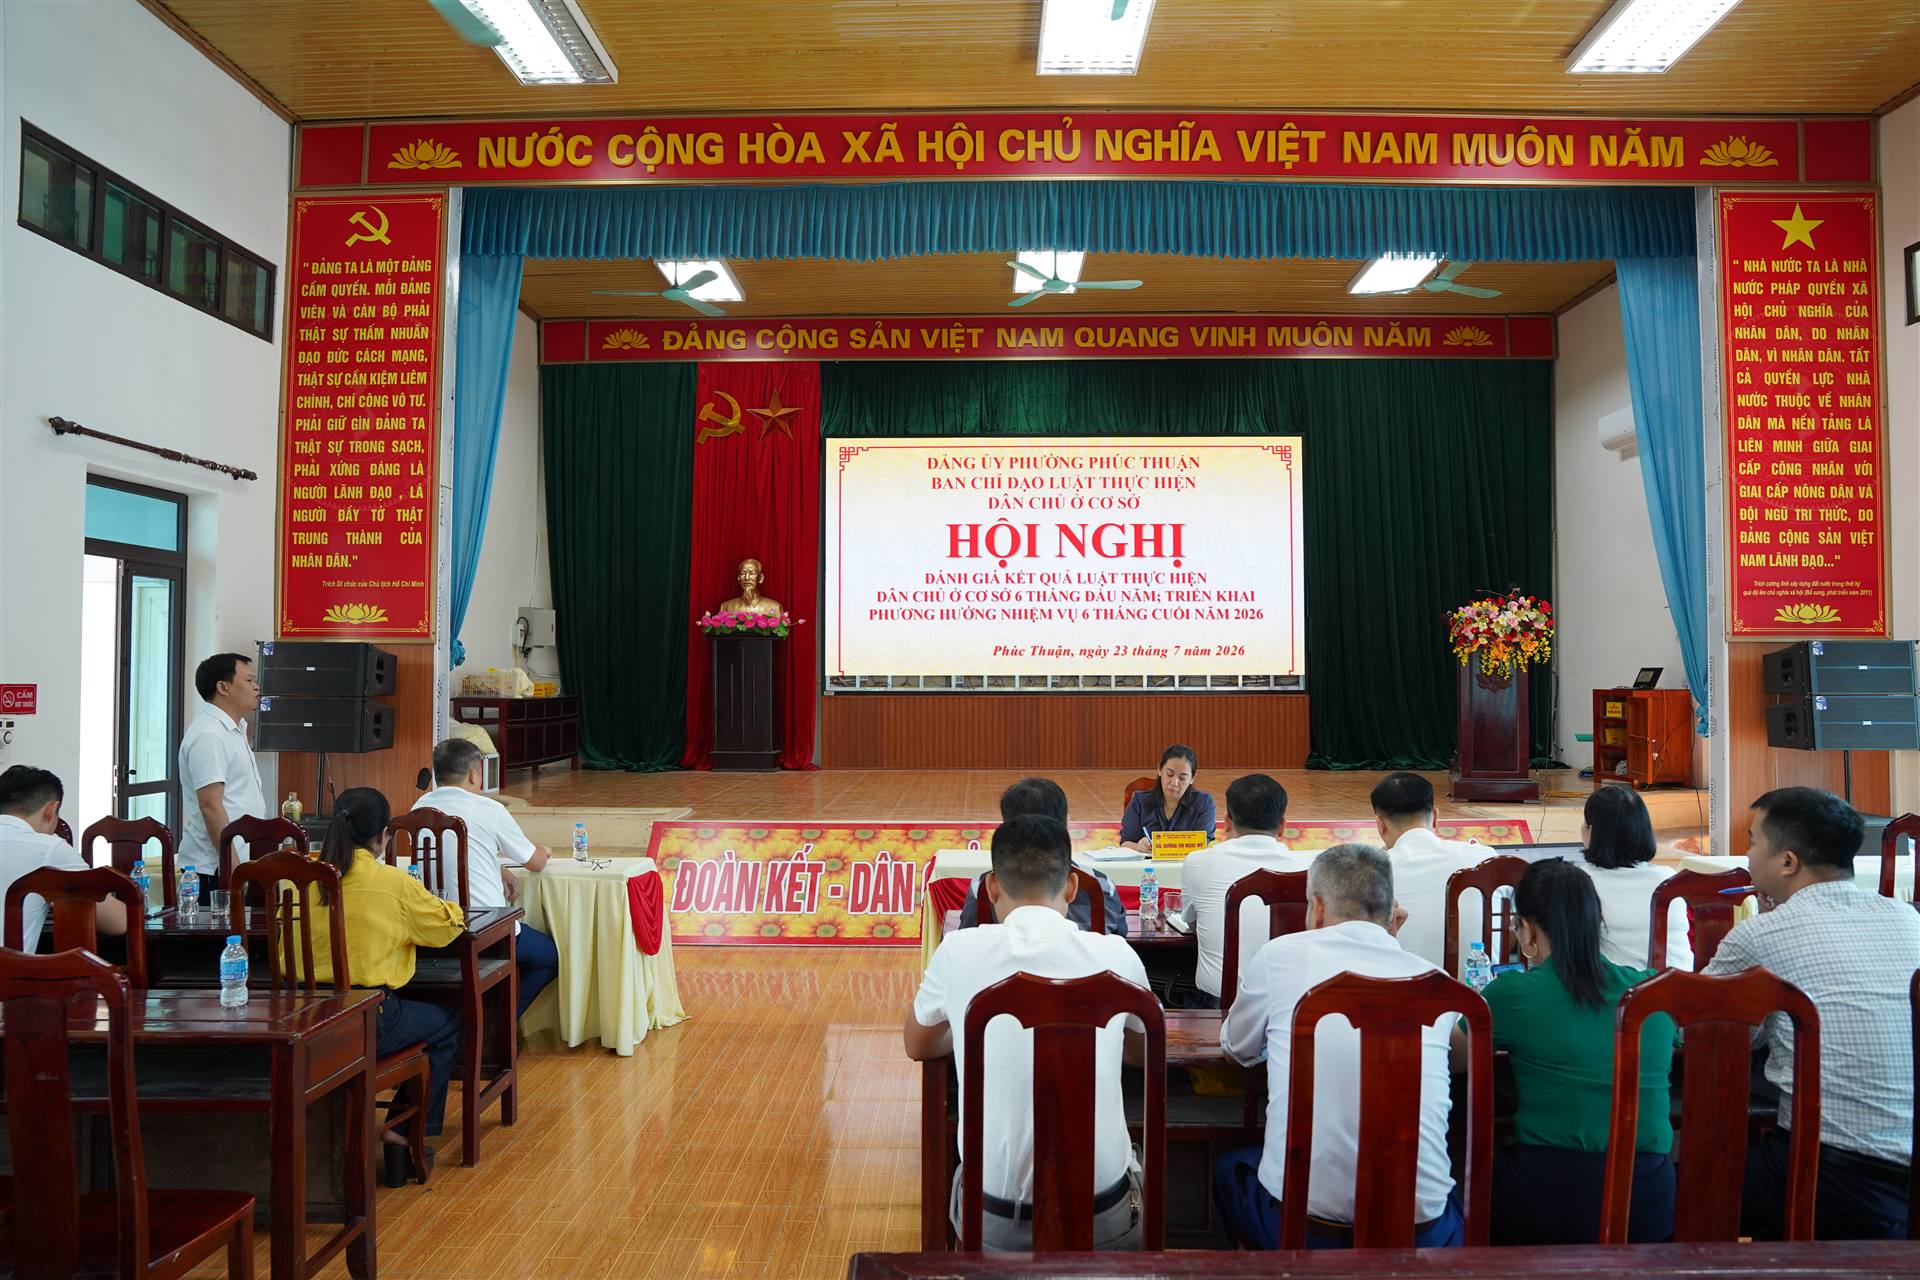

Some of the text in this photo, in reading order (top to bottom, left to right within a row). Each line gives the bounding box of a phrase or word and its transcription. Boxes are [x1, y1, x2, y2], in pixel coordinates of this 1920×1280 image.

[479, 113, 1683, 176] NƯỚC CỘNG HÒA XÃ HỘI CHỦ NGHĨA VIỆT NAM MUÔN NĂM
[1734, 278, 1867, 296] NƯỚC PHÁP QUYỀN XÃ
[301, 300, 429, 319] VIÊN VÀ CÁN BỘ PHẢI
[1734, 300, 1868, 319] HỘI CHỦ NGHĨA CỦA
[663, 320, 1431, 354] ĐẢNG CỘNG SẢN VIỆT NAM QUANG VINH MUÔN NĂM
[1735, 325, 1868, 341] NHÂN DÂN, DO NHÂN
[299, 347, 427, 365] ĐẠO ĐỨC CÁCH MẠNG,
[1736, 345, 1869, 363] DÂN, VÌ NHÂN DÂN. TẤT
[297, 393, 332, 409] CHÍNH,
[359, 392, 388, 407] CÔNG
[392, 392, 405, 407] VÔ
[410, 394, 425, 407] TƯ.
[296, 413, 425, 430] PHẢI GIỮ GÌN ĐẢNG TA
[295, 438, 424, 456] THẬT SỰ TRONG SẠCH,
[1738, 437, 1872, 453] LIÊN MINH GIỮA GIAI
[295, 459, 423, 476] PHẢI XỨNG ĐÁNG LÀ
[928, 454, 1199, 472] ĐẢNG ỦY PHƯỜNG PHÚC THUẬN
[1739, 458, 1872, 475] CẤP CÔNG NHÂN VỚI
[932, 474, 1195, 492] BAN CHỈ ĐẠO LUẬT THỰC HIỆN
[989, 493, 1140, 509] DÂN CHỦ Ở CƠ SỞ
[293, 527, 422, 544] TRUNG THÀNH CỦA
[946, 518, 1185, 568] HỘI NGHỊ
[1740, 526, 1873, 546] ĐẢNG CỘNG SẢN VIỆT
[292, 552, 322, 567] NHÂN
[926, 570, 1206, 587] ĐÁNH GIÁ KẾT QUẢ LUẬT THỰC HIỆN
[877, 588, 1254, 603] DÂN CHỦ Ở CƠ SỞ 6 THÁNG ĐẦU NĂM; TRIỂN KHAI
[870, 605, 1263, 623] PHƯƠNG HƯỚNG NHIỆM VỤ 6 THÁNG CUỐI NĂM 2026
[993, 645, 1245, 659] Phúc Thuận, ngày 23 tháng 7 năm 2026
[671, 850, 762, 913] ĐOÀN
[763, 843, 826, 914] KẾT
[848, 851, 917, 915] DÂN
